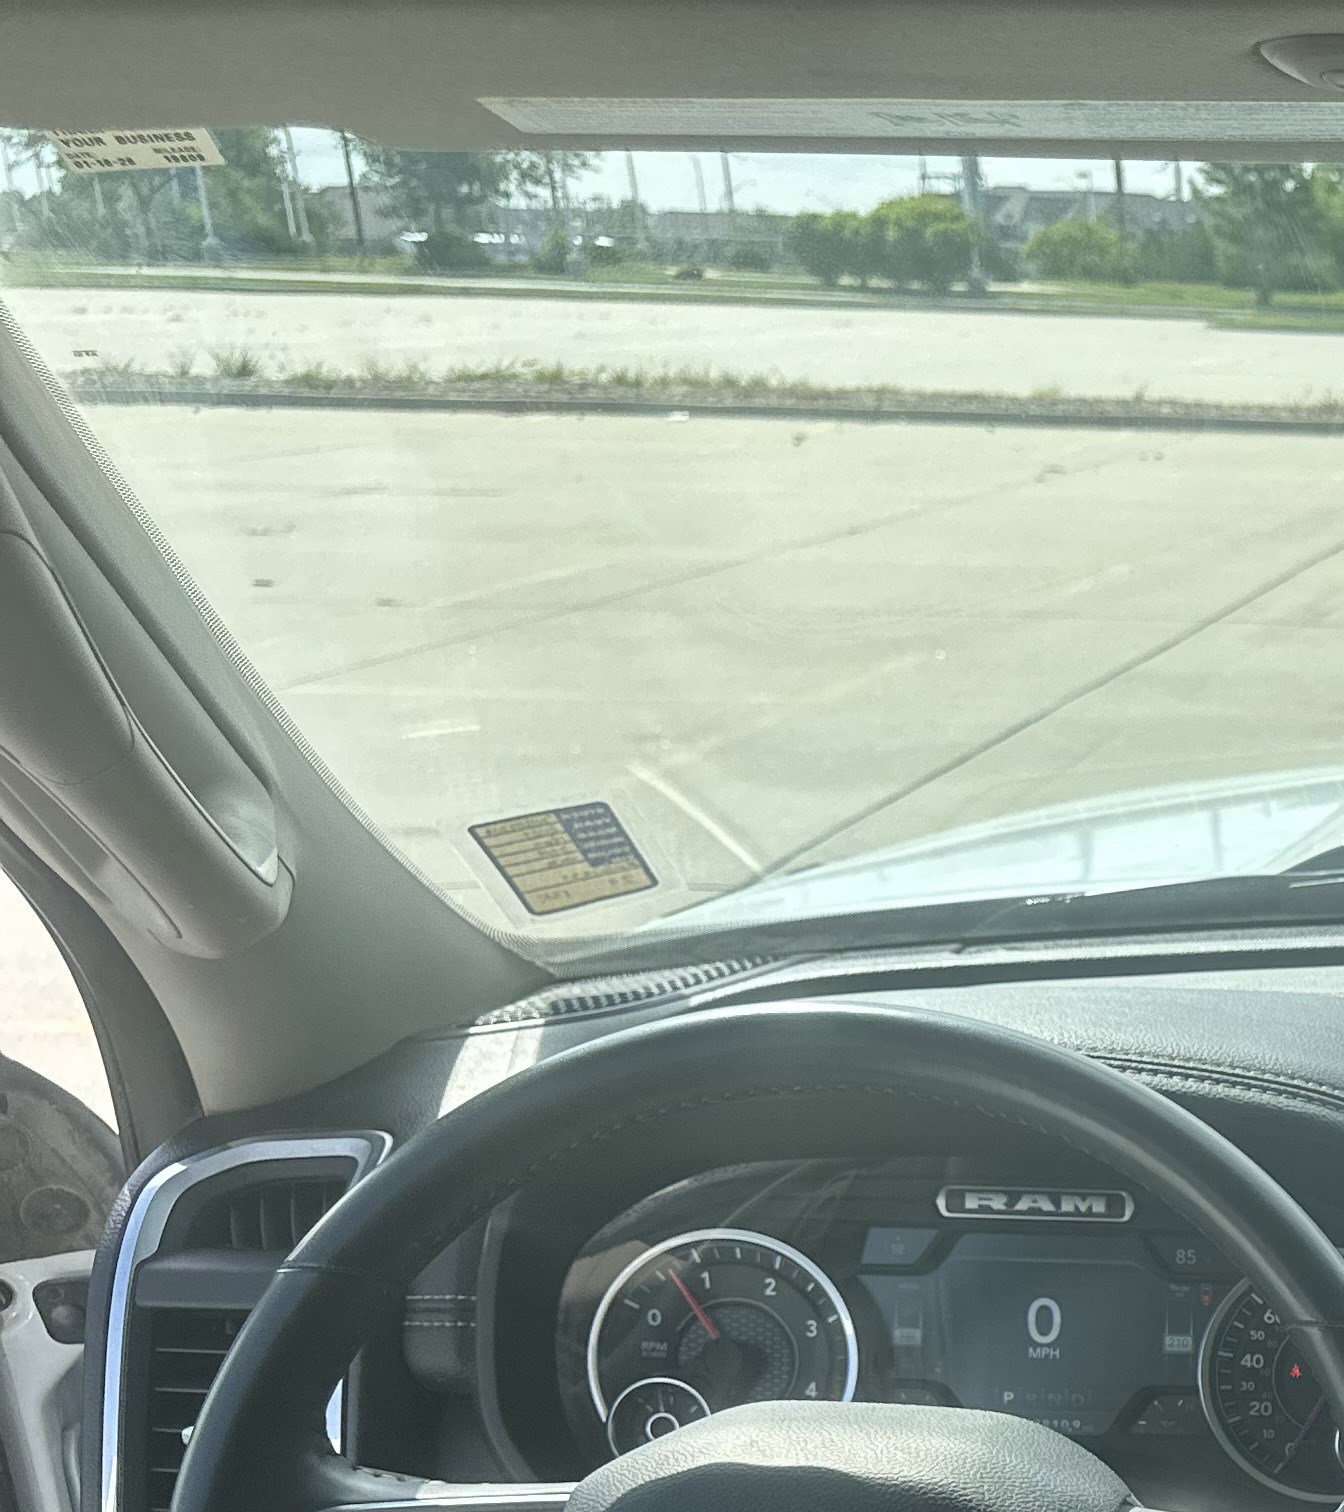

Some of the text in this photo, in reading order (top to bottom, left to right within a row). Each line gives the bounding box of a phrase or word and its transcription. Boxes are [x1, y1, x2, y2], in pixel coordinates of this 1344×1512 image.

[58, 136, 107, 148] YOUR
[114, 131, 197, 145] BUSINESS
[964, 1192, 1108, 1214] RAM
[1175, 1249, 1197, 1265] 85
[700, 1271, 711, 1290] 1
[763, 1277, 778, 1296] 2
[647, 1309, 662, 1327] 0
[1027, 1297, 1062, 1345] 0
[805, 1319, 818, 1338] 3
[1250, 1330, 1265, 1341] 50
[1029, 1347, 1060, 1360] MPH
[1240, 1354, 1264, 1369] 40
[804, 1381, 818, 1399] 4
[1240, 1381, 1255, 1392] 30
[1003, 1391, 1014, 1405] P
[1249, 1402, 1272, 1416] 20
[1263, 1429, 1275, 1439] 10
